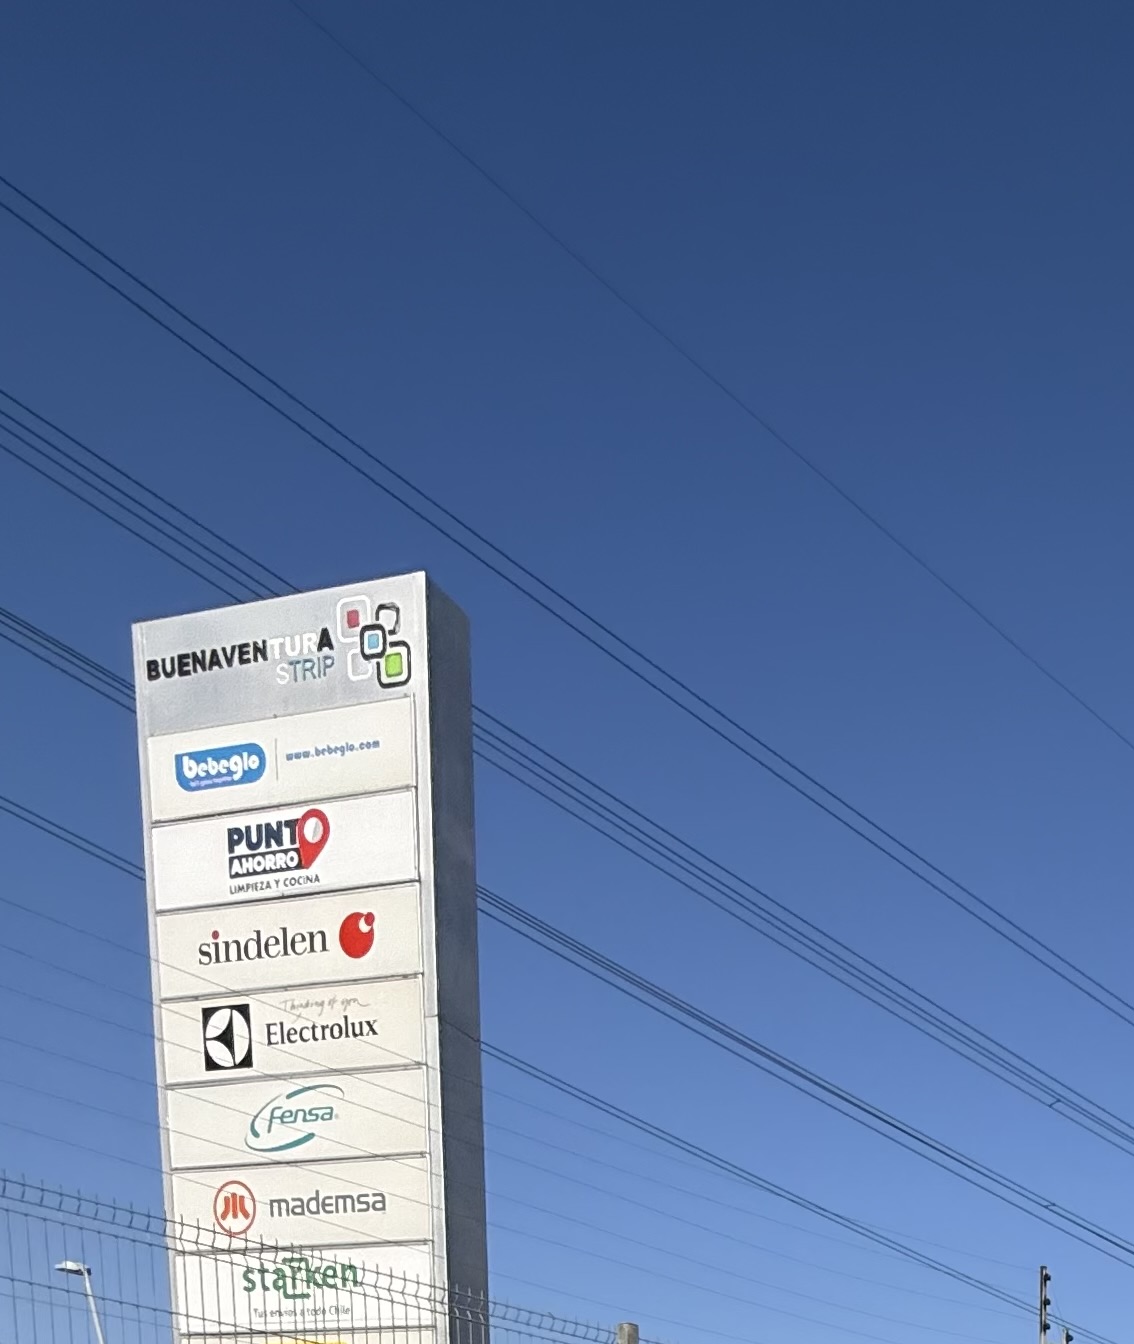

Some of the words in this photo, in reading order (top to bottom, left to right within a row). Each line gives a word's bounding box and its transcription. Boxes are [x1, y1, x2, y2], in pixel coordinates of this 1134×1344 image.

[146, 627, 334, 681] BUENAVENTURA
[276, 655, 335, 685] STRIP
[286, 740, 380, 761] www.bebeglo.com
[182, 752, 260, 781] bebeglo
[231, 850, 299, 876] AHORRO
[229, 880, 272, 895] LIMPIEZA
[273, 878, 281, 889] Y
[283, 873, 320, 888] COCINA
[198, 926, 329, 966] sindelen
[265, 1015, 379, 1047] Electrolux
[267, 1106, 334, 1134] fensa
[269, 1190, 387, 1217] mademsa
[242, 1257, 358, 1299] starken
